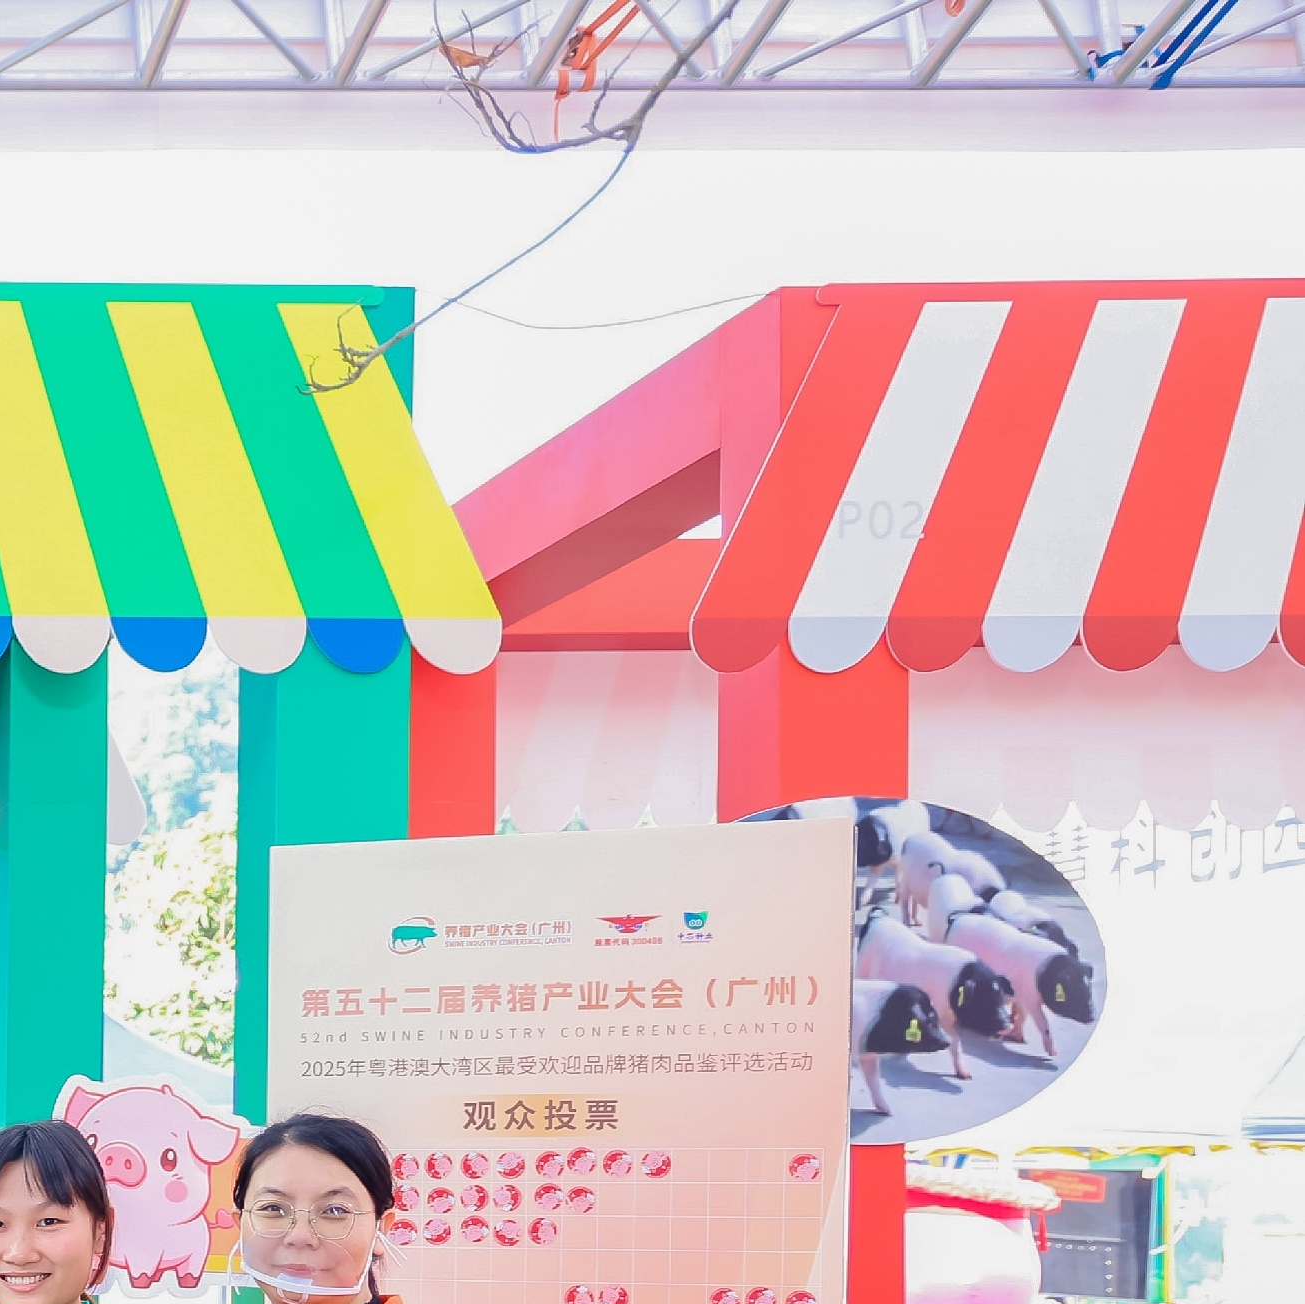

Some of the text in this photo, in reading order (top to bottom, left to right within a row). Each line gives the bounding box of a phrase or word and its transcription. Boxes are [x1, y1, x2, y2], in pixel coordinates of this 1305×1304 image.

[838, 500, 925, 539] P02
[444, 920, 572, 938] 养猪产业大会(广州)
[466, 939, 497, 947] INDUSTRY
[545, 937, 571, 945] CANTON
[301, 975, 819, 1018] 第五十二届养猪产业大会（广州）
[299, 1031, 348, 1043] 52nd
[361, 1030, 426, 1042] SWINE
[440, 1027, 546, 1041] INDUSTRY
[301, 1051, 813, 1078] 2025年粤港澳大湾区最受欢迎品牌猪肉品鉴评选活动
[463, 1099, 619, 1131] 观众投票
